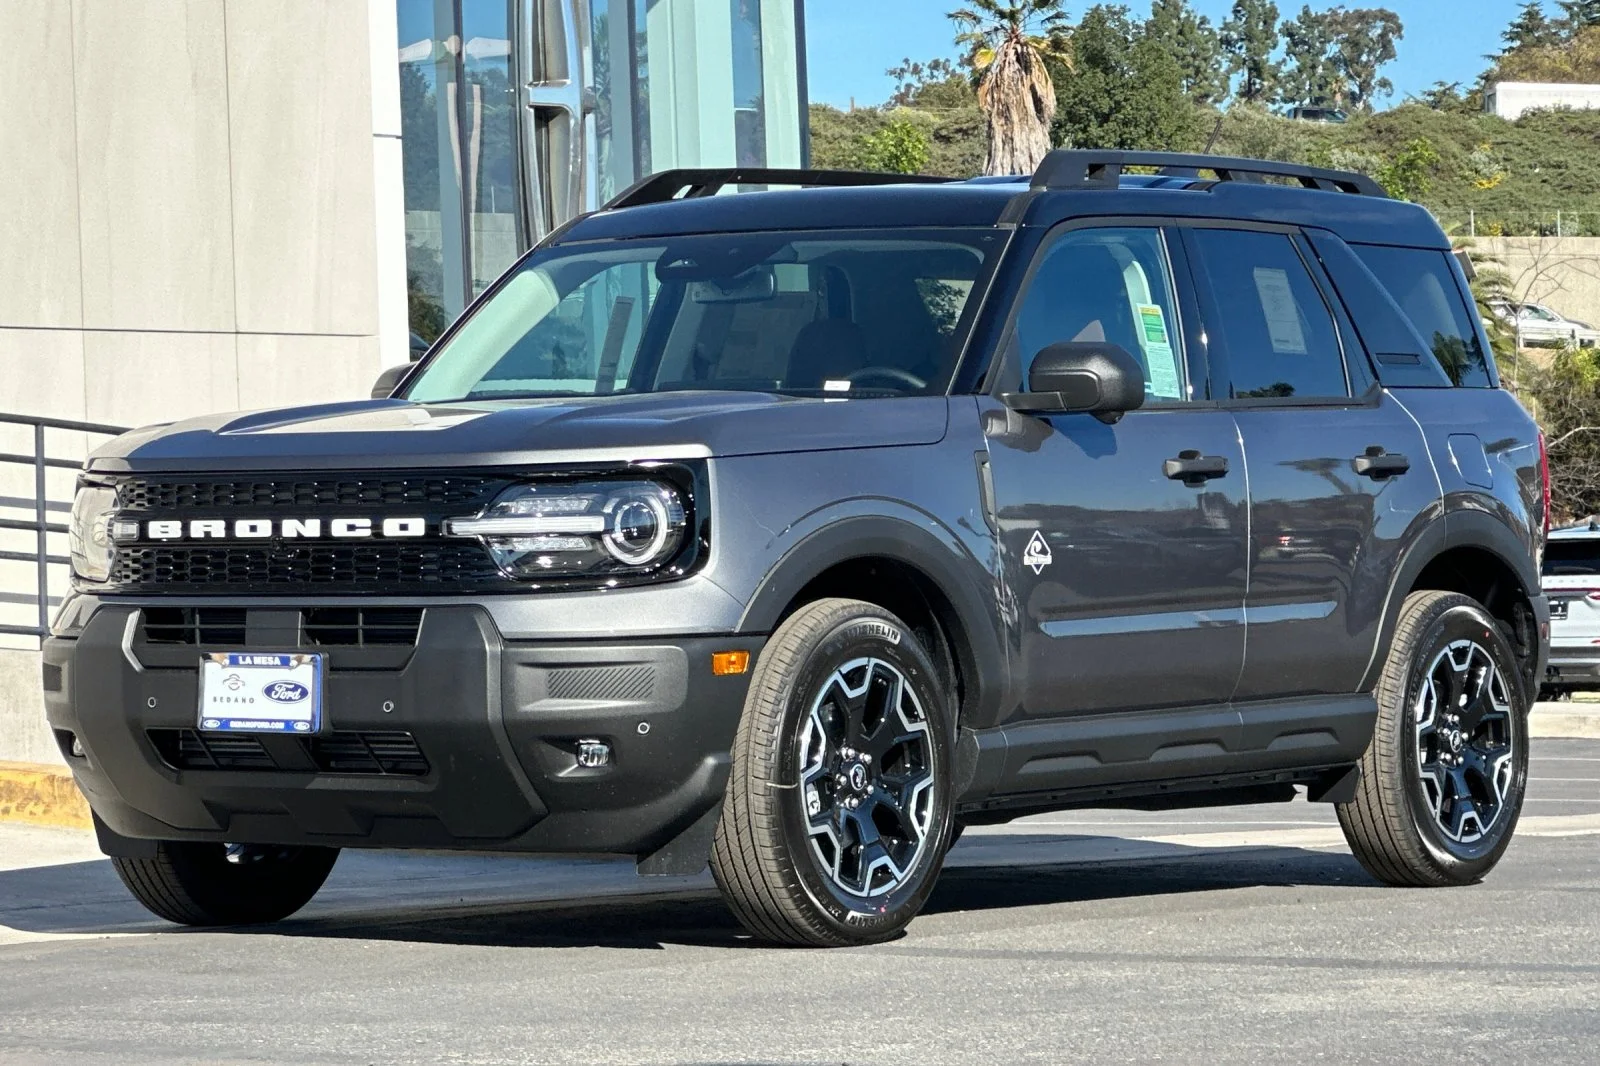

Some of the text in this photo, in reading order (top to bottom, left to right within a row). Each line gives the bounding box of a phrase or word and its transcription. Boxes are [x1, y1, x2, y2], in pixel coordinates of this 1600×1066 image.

[148, 517, 426, 539] BRONCO
[238, 656, 281, 666] LA MESA
[271, 683, 301, 700] Ford
